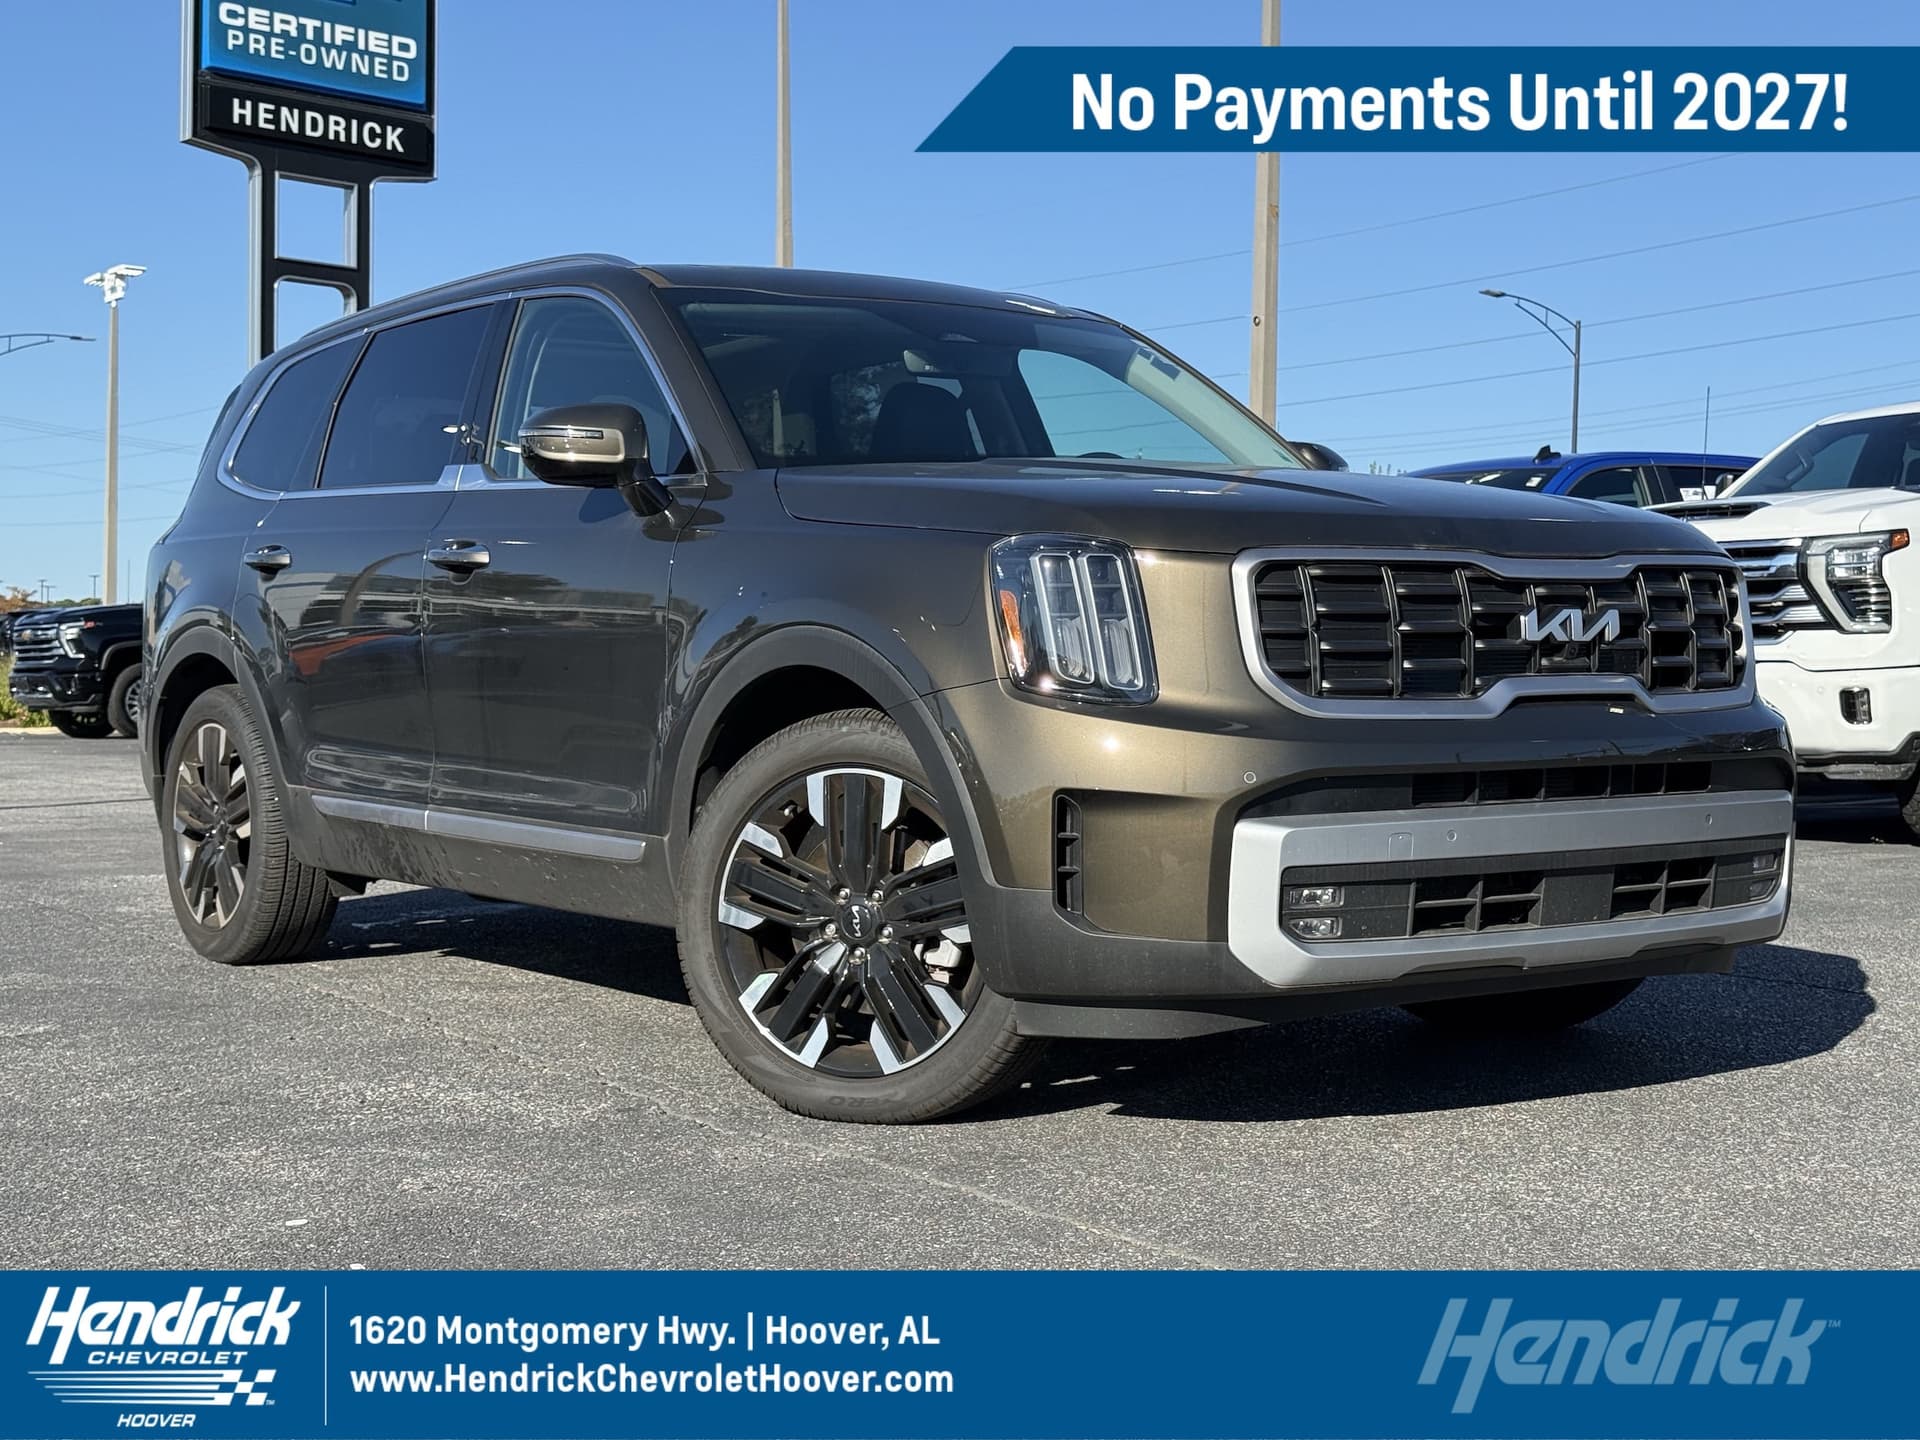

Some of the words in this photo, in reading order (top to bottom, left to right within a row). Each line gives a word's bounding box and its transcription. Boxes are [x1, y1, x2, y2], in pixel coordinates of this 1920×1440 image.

[218, 2, 417, 60] CERTIFIED
[227, 30, 409, 82] PRE-OWNED
[232, 97, 405, 153] HENDRICK
[1520, 607, 1620, 642] KIA
